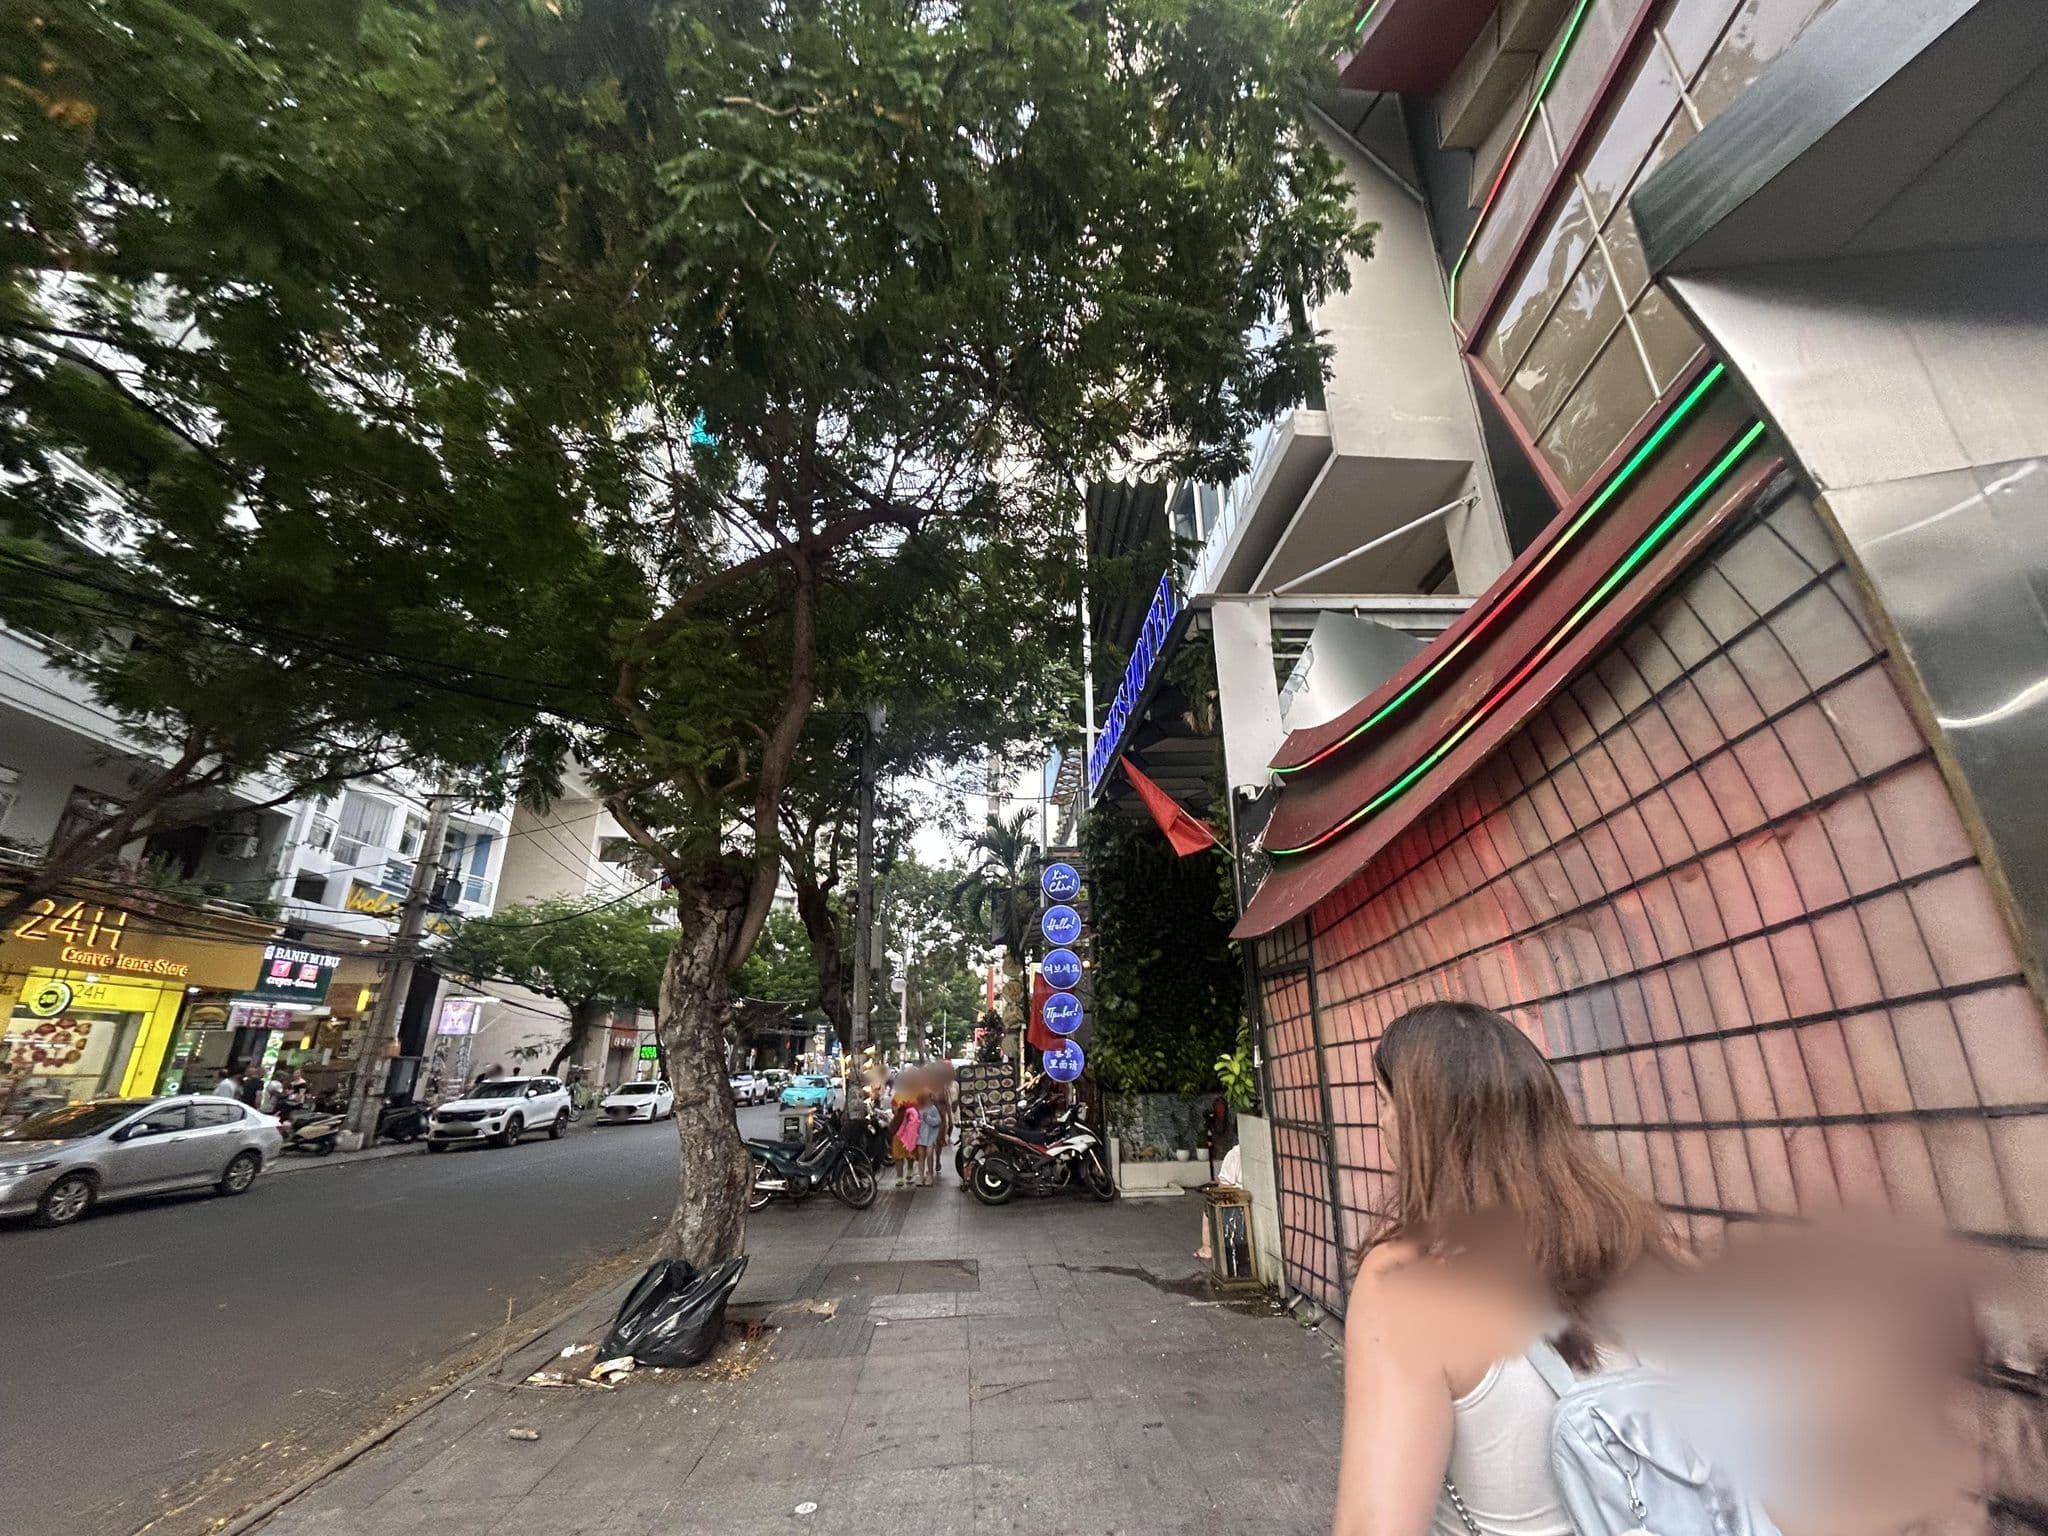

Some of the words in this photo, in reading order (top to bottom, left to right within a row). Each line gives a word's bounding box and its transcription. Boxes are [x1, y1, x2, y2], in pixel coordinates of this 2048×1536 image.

[1125, 569, 1179, 715] HOTEL
[15, 898, 128, 951] 24H
[1046, 917, 1076, 931] Hello!
[1044, 963, 1080, 975] 여보세요
[73, 984, 107, 1000] 24H
